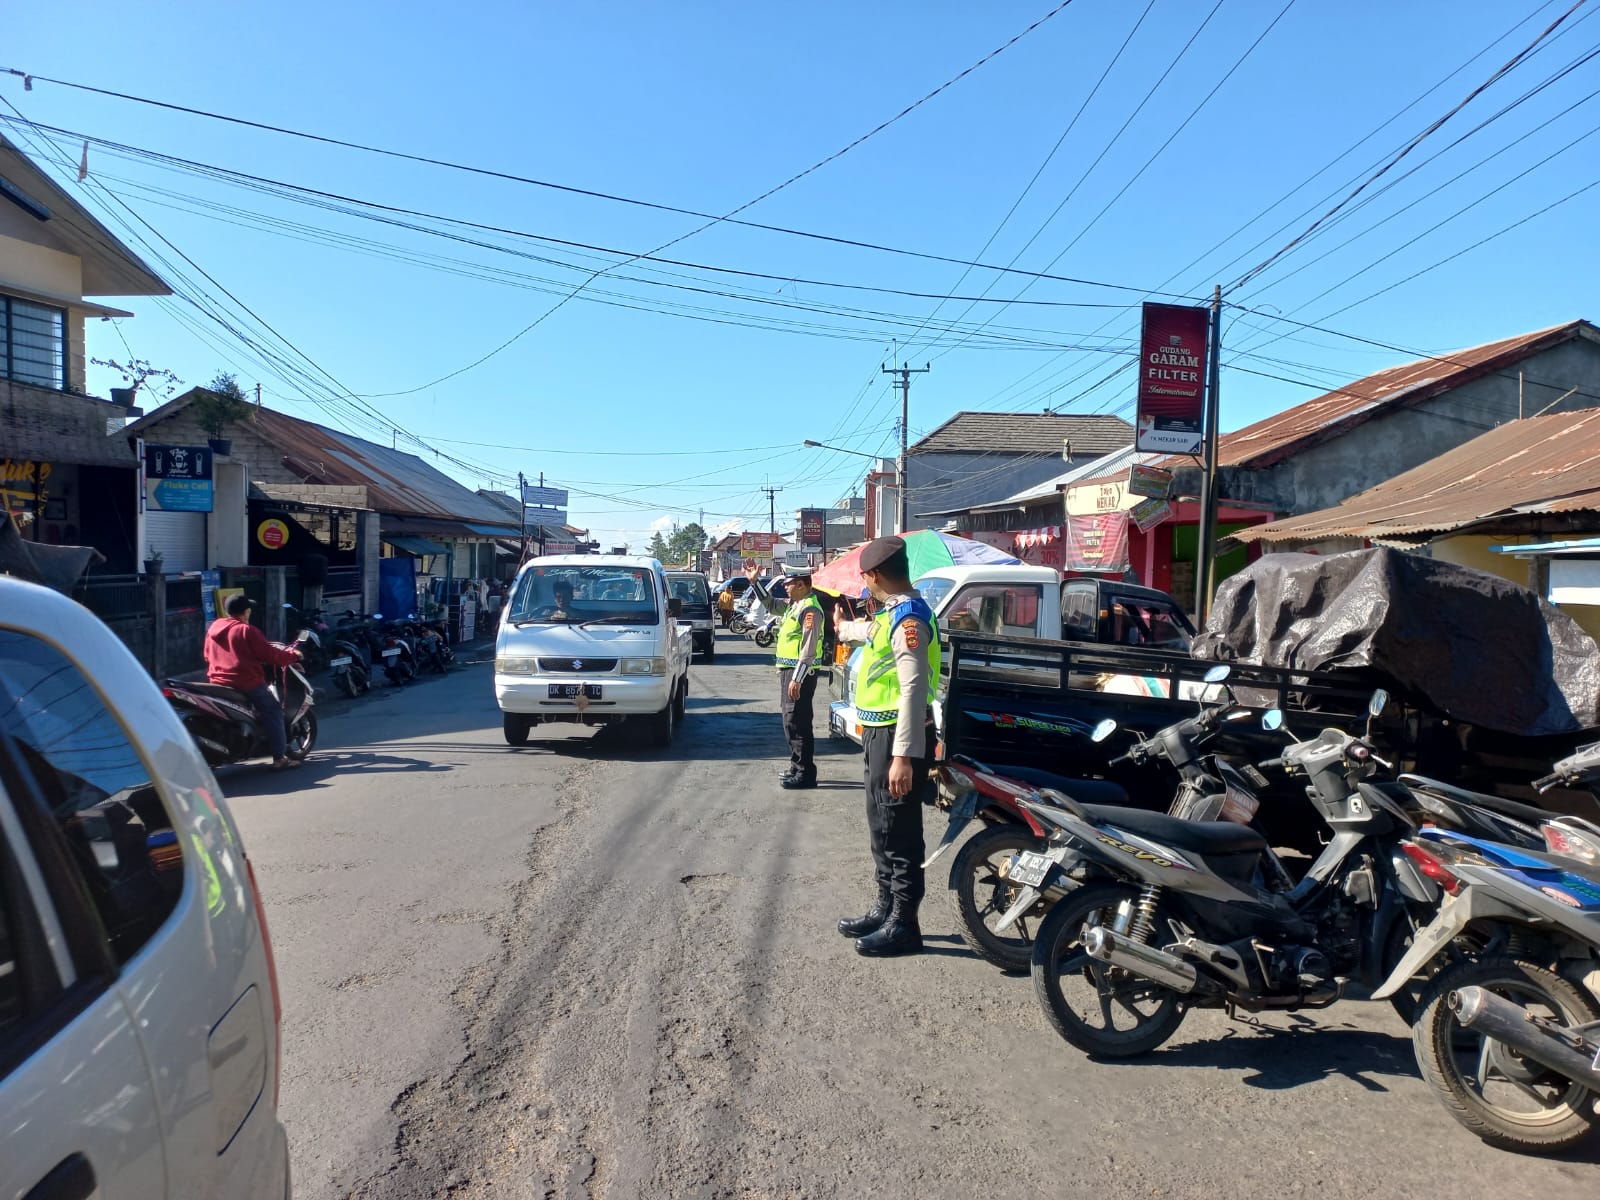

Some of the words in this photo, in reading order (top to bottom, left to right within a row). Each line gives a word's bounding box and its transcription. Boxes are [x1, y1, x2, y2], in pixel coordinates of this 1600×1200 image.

[1160, 346, 1191, 355] GUDANG
[1150, 352, 1200, 368] GARAM
[1148, 368, 1198, 382] FILTER
[0, 457, 53, 484] luke
[549, 684, 560, 695] DK
[1096, 833, 1173, 868] REVO
